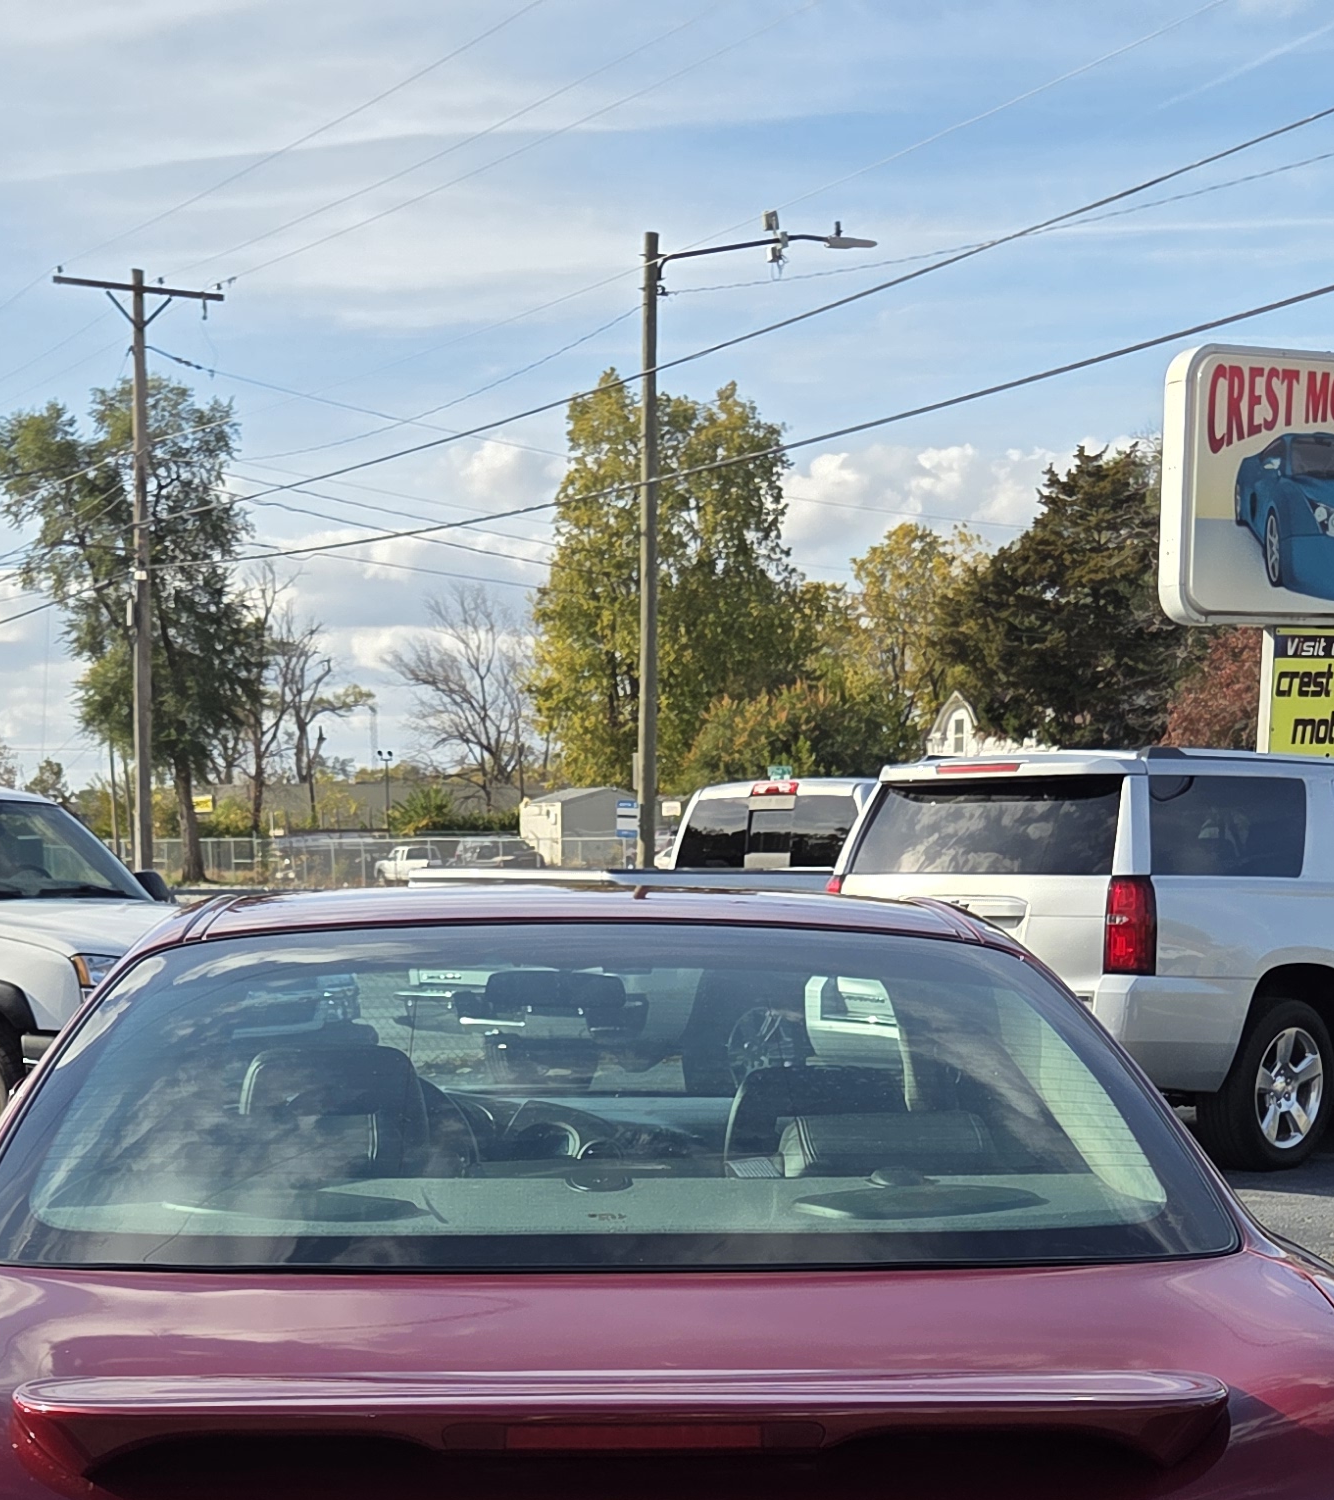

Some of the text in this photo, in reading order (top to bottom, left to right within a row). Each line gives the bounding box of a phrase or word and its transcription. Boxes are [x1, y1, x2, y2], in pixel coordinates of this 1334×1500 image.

[1207, 363, 1300, 454] CREST
[1287, 637, 1327, 656] Visit
[1275, 663, 1334, 697] crest
